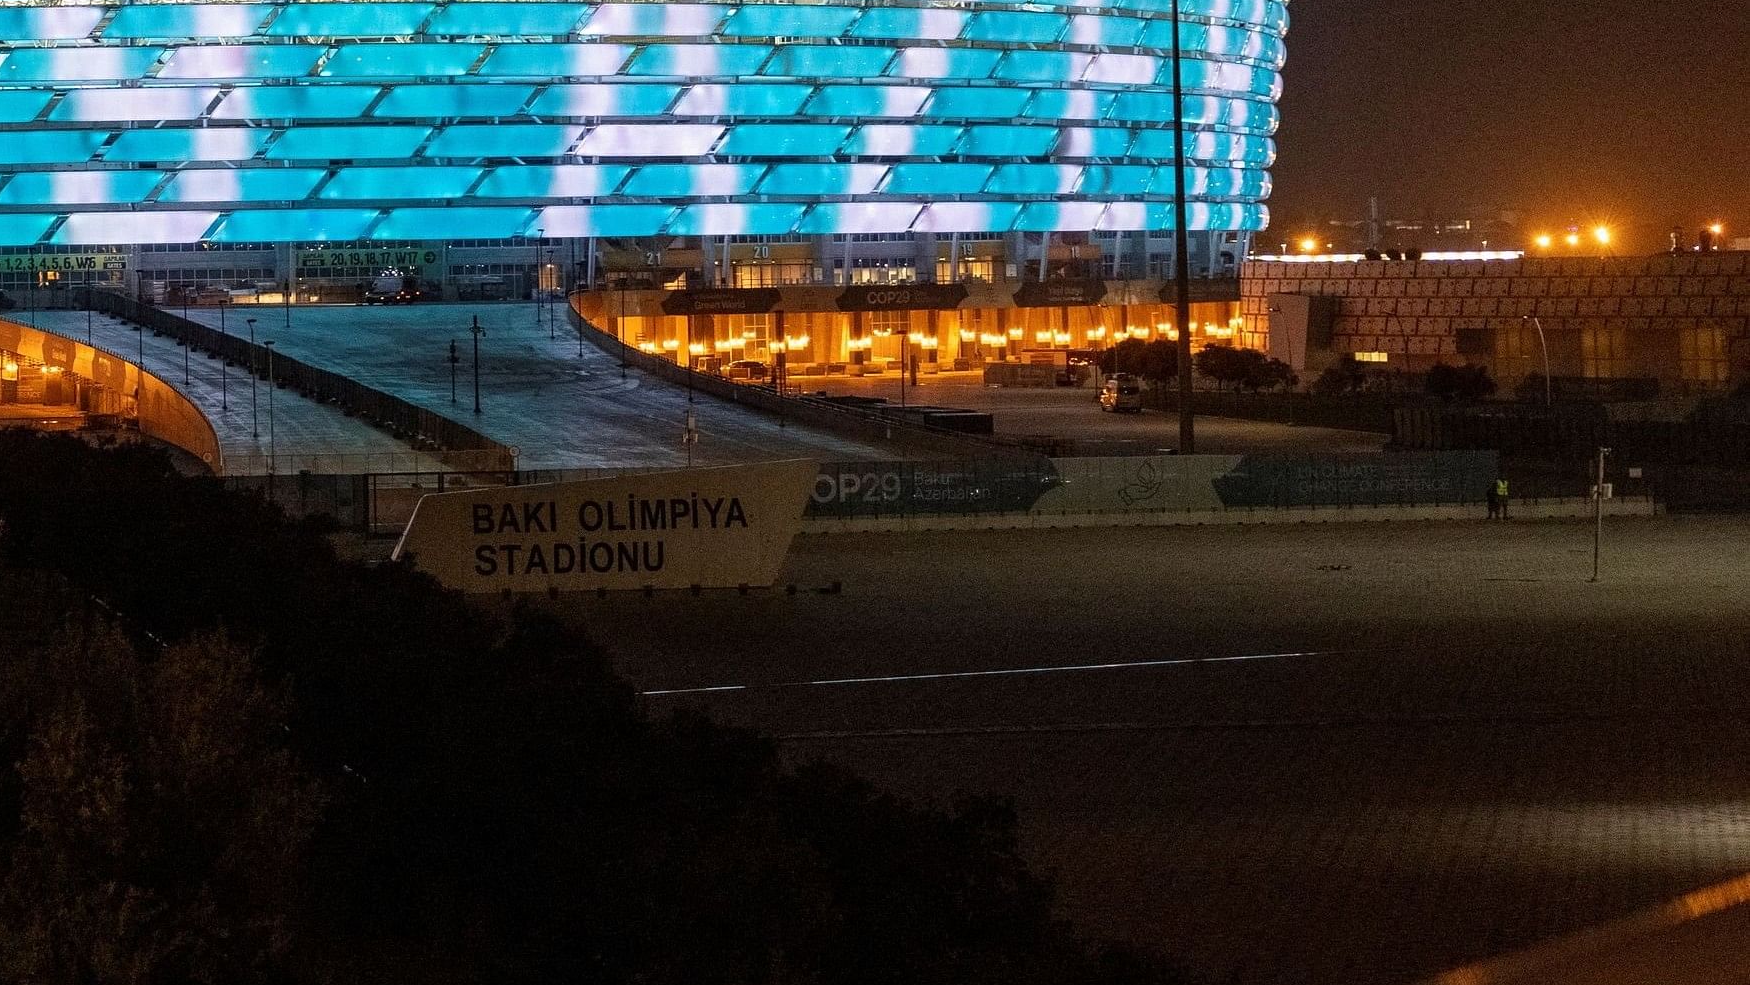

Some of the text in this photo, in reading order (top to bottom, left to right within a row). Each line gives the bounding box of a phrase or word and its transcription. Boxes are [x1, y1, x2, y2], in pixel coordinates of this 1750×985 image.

[646, 251, 661, 266] 21
[753, 245, 770, 258] 20
[867, 291, 910, 305] COP29
[914, 471, 953, 486] Baku
[811, 473, 901, 503] OP29
[914, 486, 991, 503] Azerbaijan
[473, 492, 748, 534] BAKI OLİMPİYA
[474, 536, 665, 576] STADİONU
